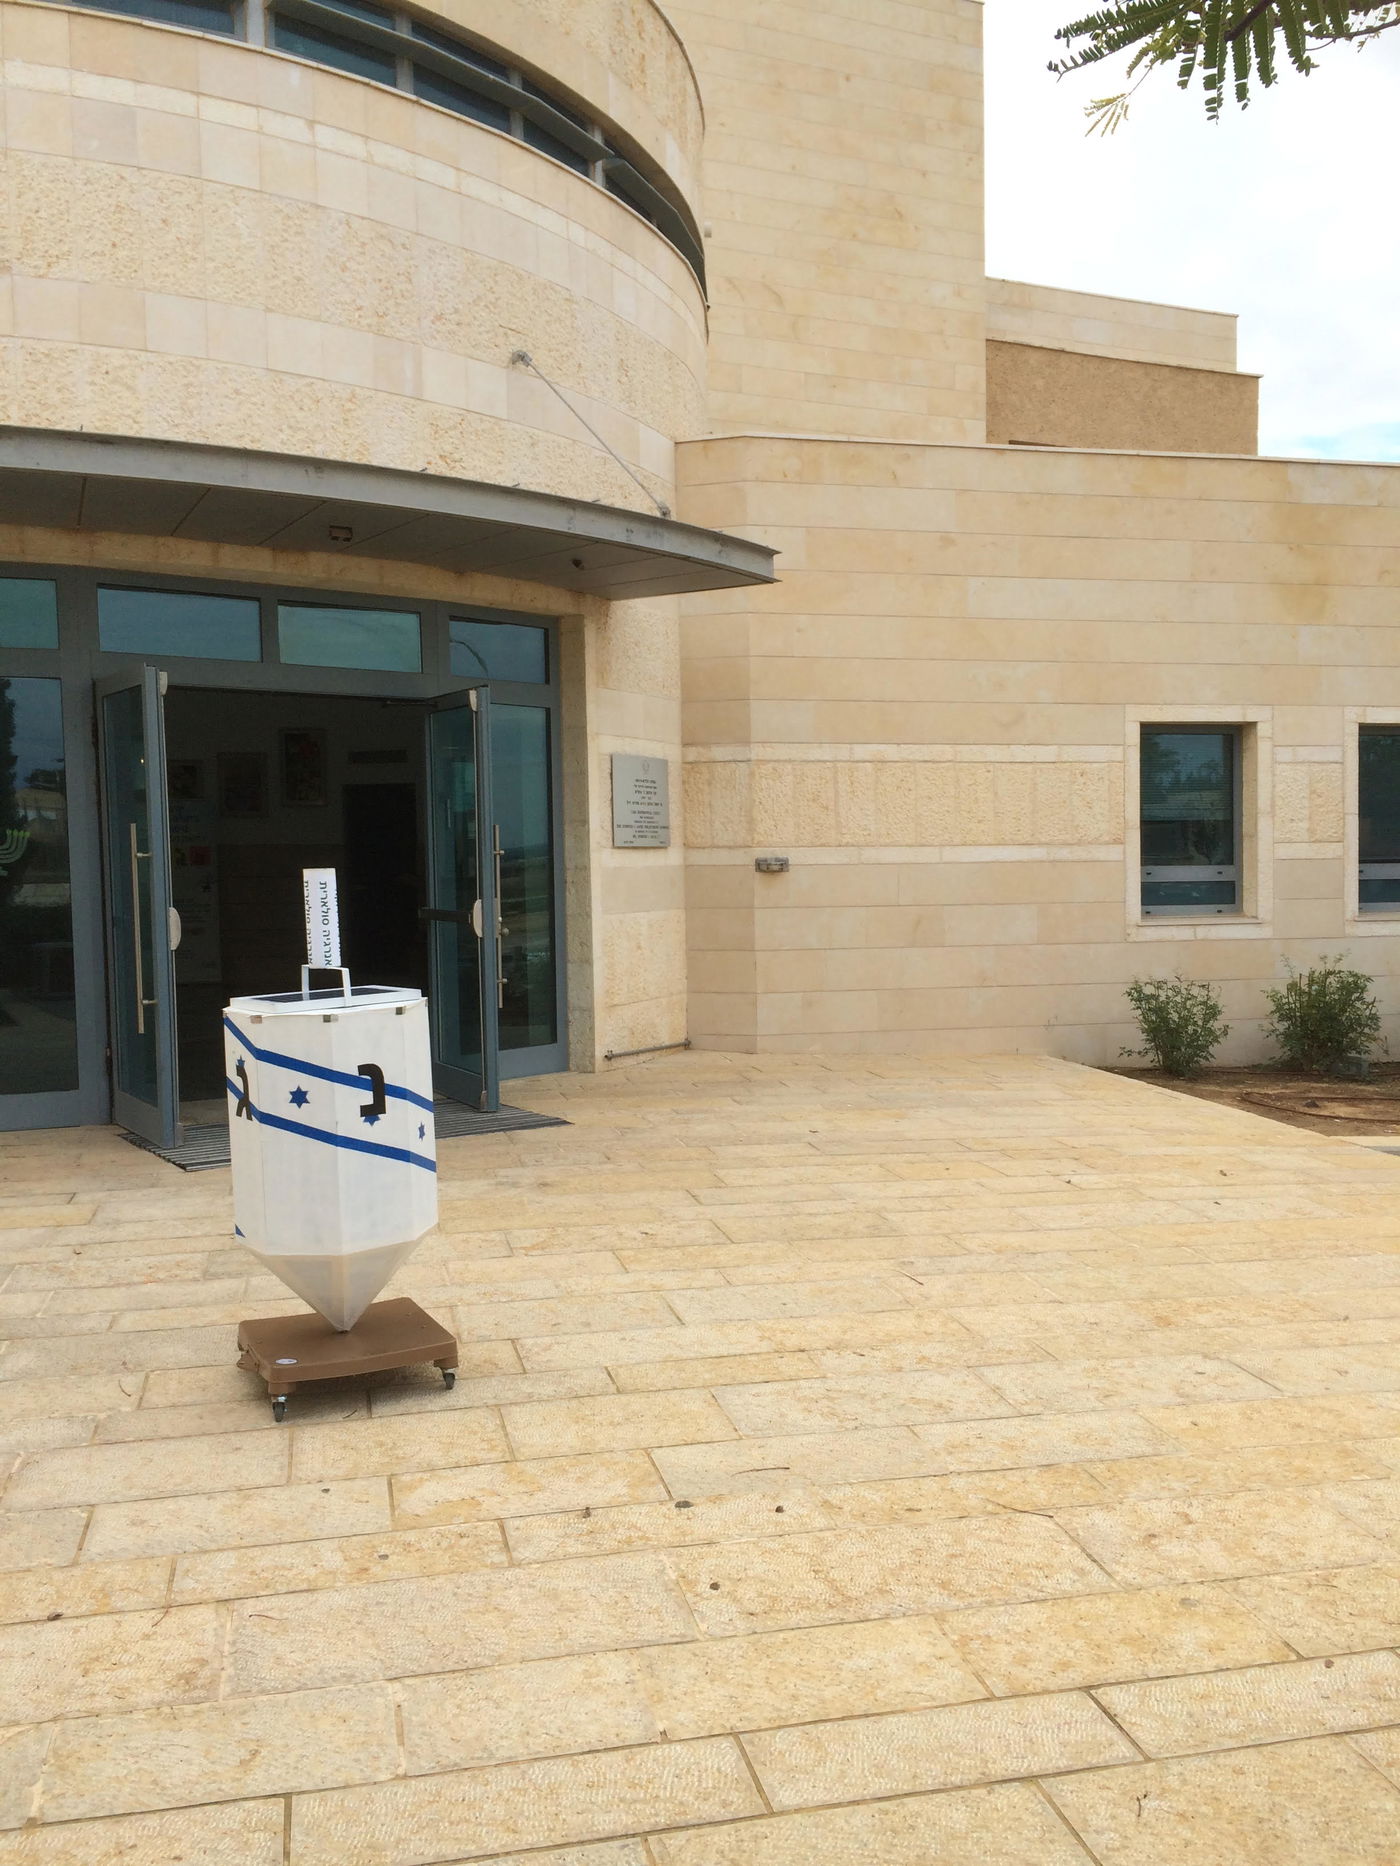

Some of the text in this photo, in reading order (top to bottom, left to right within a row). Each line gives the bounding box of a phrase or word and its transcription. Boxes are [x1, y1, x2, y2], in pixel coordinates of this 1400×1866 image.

[319, 880, 333, 966] אנרגיה סולארית
[236, 1064, 253, 1121] ג
[357, 1063, 386, 1117] נ
